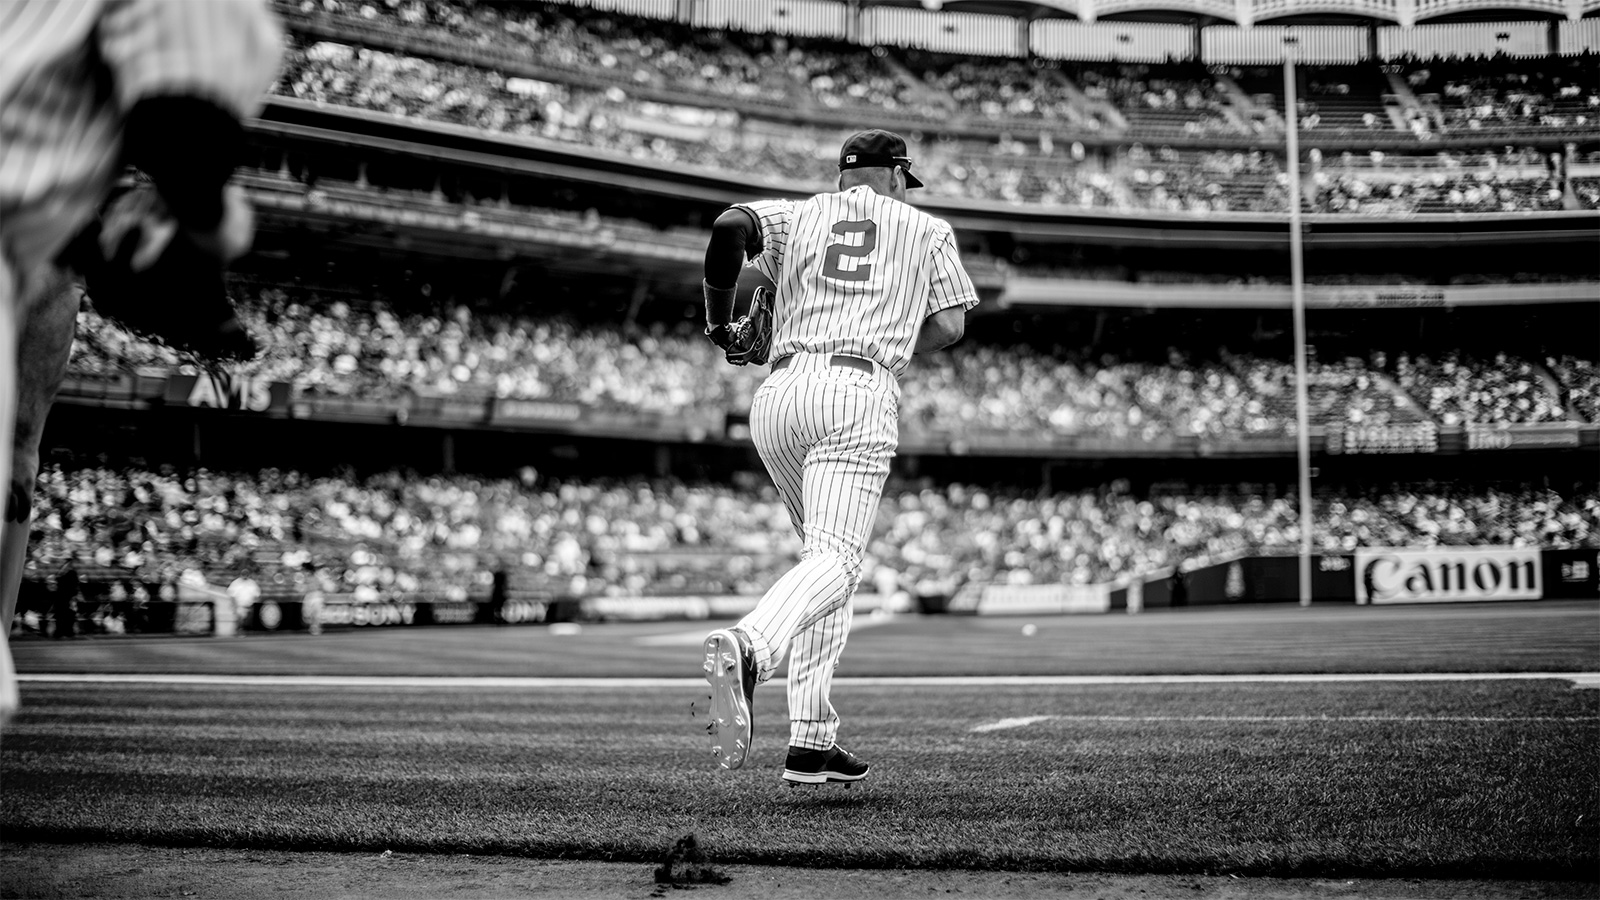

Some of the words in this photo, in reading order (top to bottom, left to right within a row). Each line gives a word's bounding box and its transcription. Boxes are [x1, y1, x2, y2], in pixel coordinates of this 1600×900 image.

[822, 219, 877, 281] 2
[187, 373, 272, 412] AVIS
[1364, 556, 1536, 594] Canon
